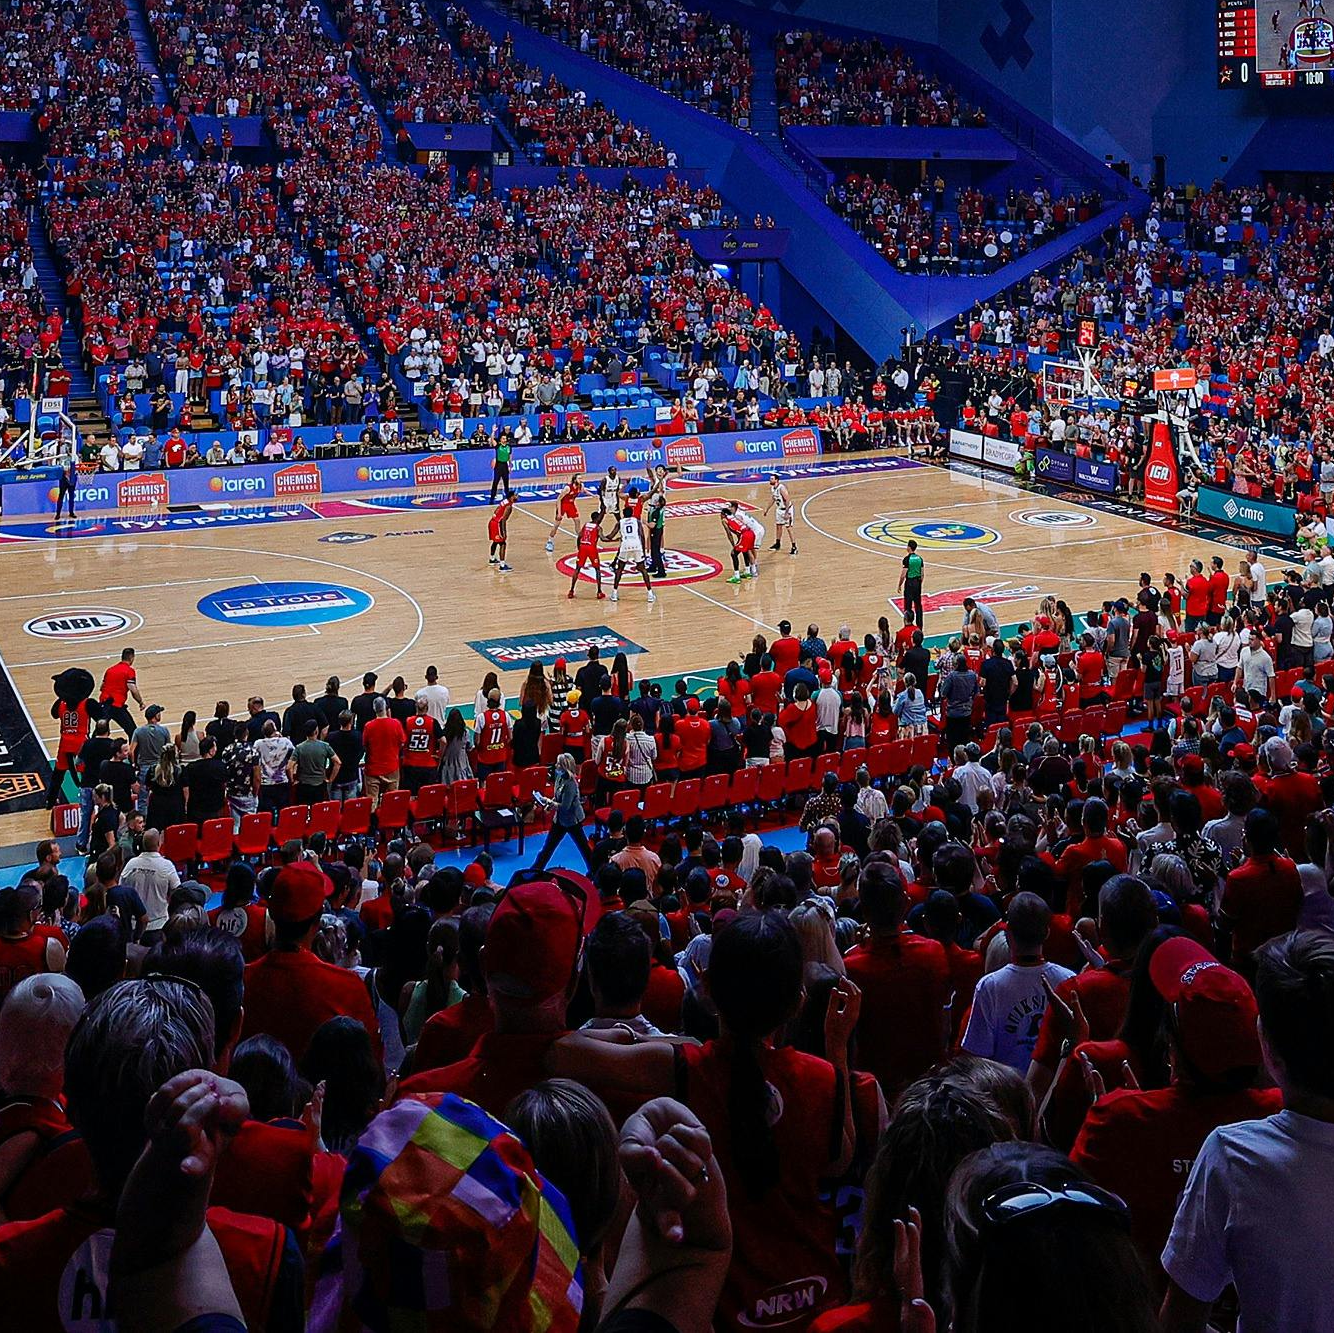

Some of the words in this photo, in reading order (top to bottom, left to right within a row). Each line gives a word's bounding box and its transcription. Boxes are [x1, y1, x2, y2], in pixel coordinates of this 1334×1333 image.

[1240, 62, 1249, 83] 0
[1080, 330, 1093, 345] 24
[784, 437, 815, 448] CHEMIST
[668, 447, 702, 458] CHEMIST
[547, 455, 582, 467] CHEMIST
[416, 464, 455, 476] CHEMIST
[1150, 465, 1168, 480] IGA
[276, 474, 318, 486] CHEMIST
[120, 484, 166, 499] CHEMIST
[113, 508, 302, 530] Tyrepower
[1091, 500, 1217, 533] PENTANET
[1239, 506, 1264, 522] CMTG
[625, 525, 633, 534] 0
[222, 601, 255, 611] La
[260, 590, 338, 606] Trobe
[47, 616, 110, 632] NBL
[409, 734, 429, 749] 53
[490, 728, 502, 744] 11
[219, 918, 237, 931] hif
[753, 1284, 816, 1319] NRW
